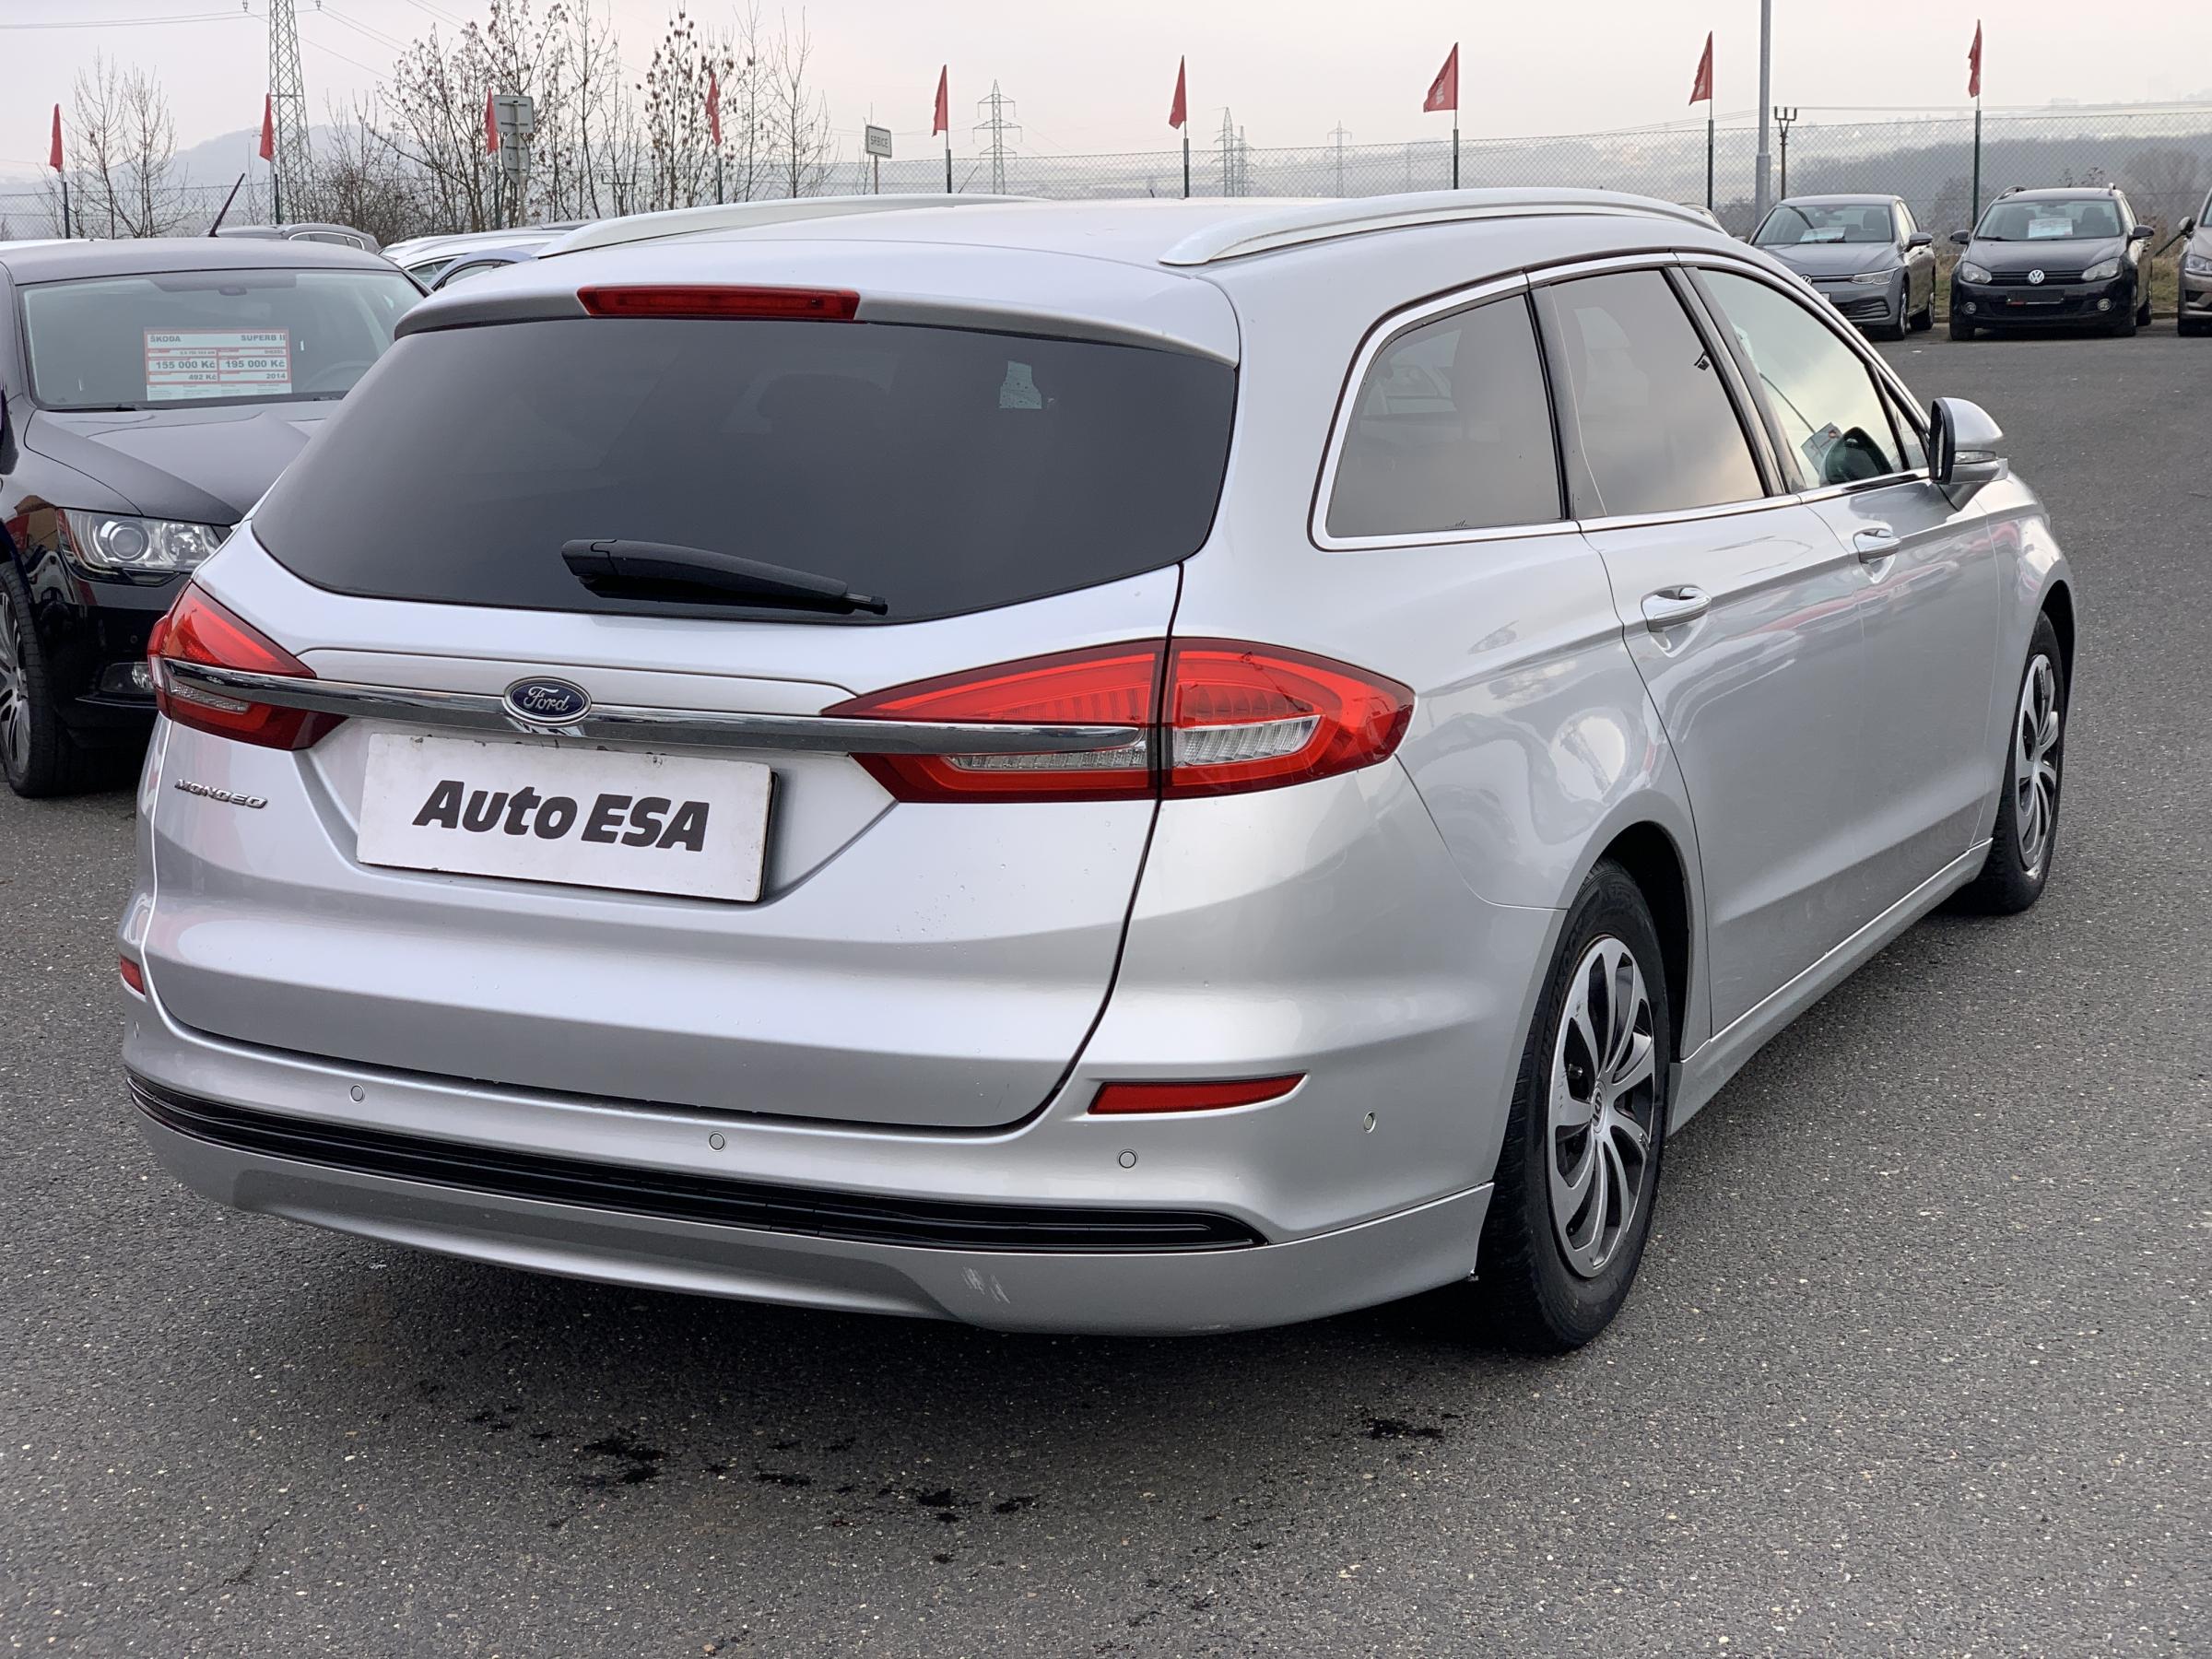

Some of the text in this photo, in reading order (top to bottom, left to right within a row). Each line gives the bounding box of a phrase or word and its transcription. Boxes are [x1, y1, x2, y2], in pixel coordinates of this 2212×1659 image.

[241, 334, 276, 342] SUPERB
[156, 360, 216, 370] 155 000 Kč
[225, 359, 285, 369] 195 000 Kč
[523, 685, 570, 712] Ford
[174, 778, 268, 809] MONDEO
[411, 779, 710, 853] Auto ESA
